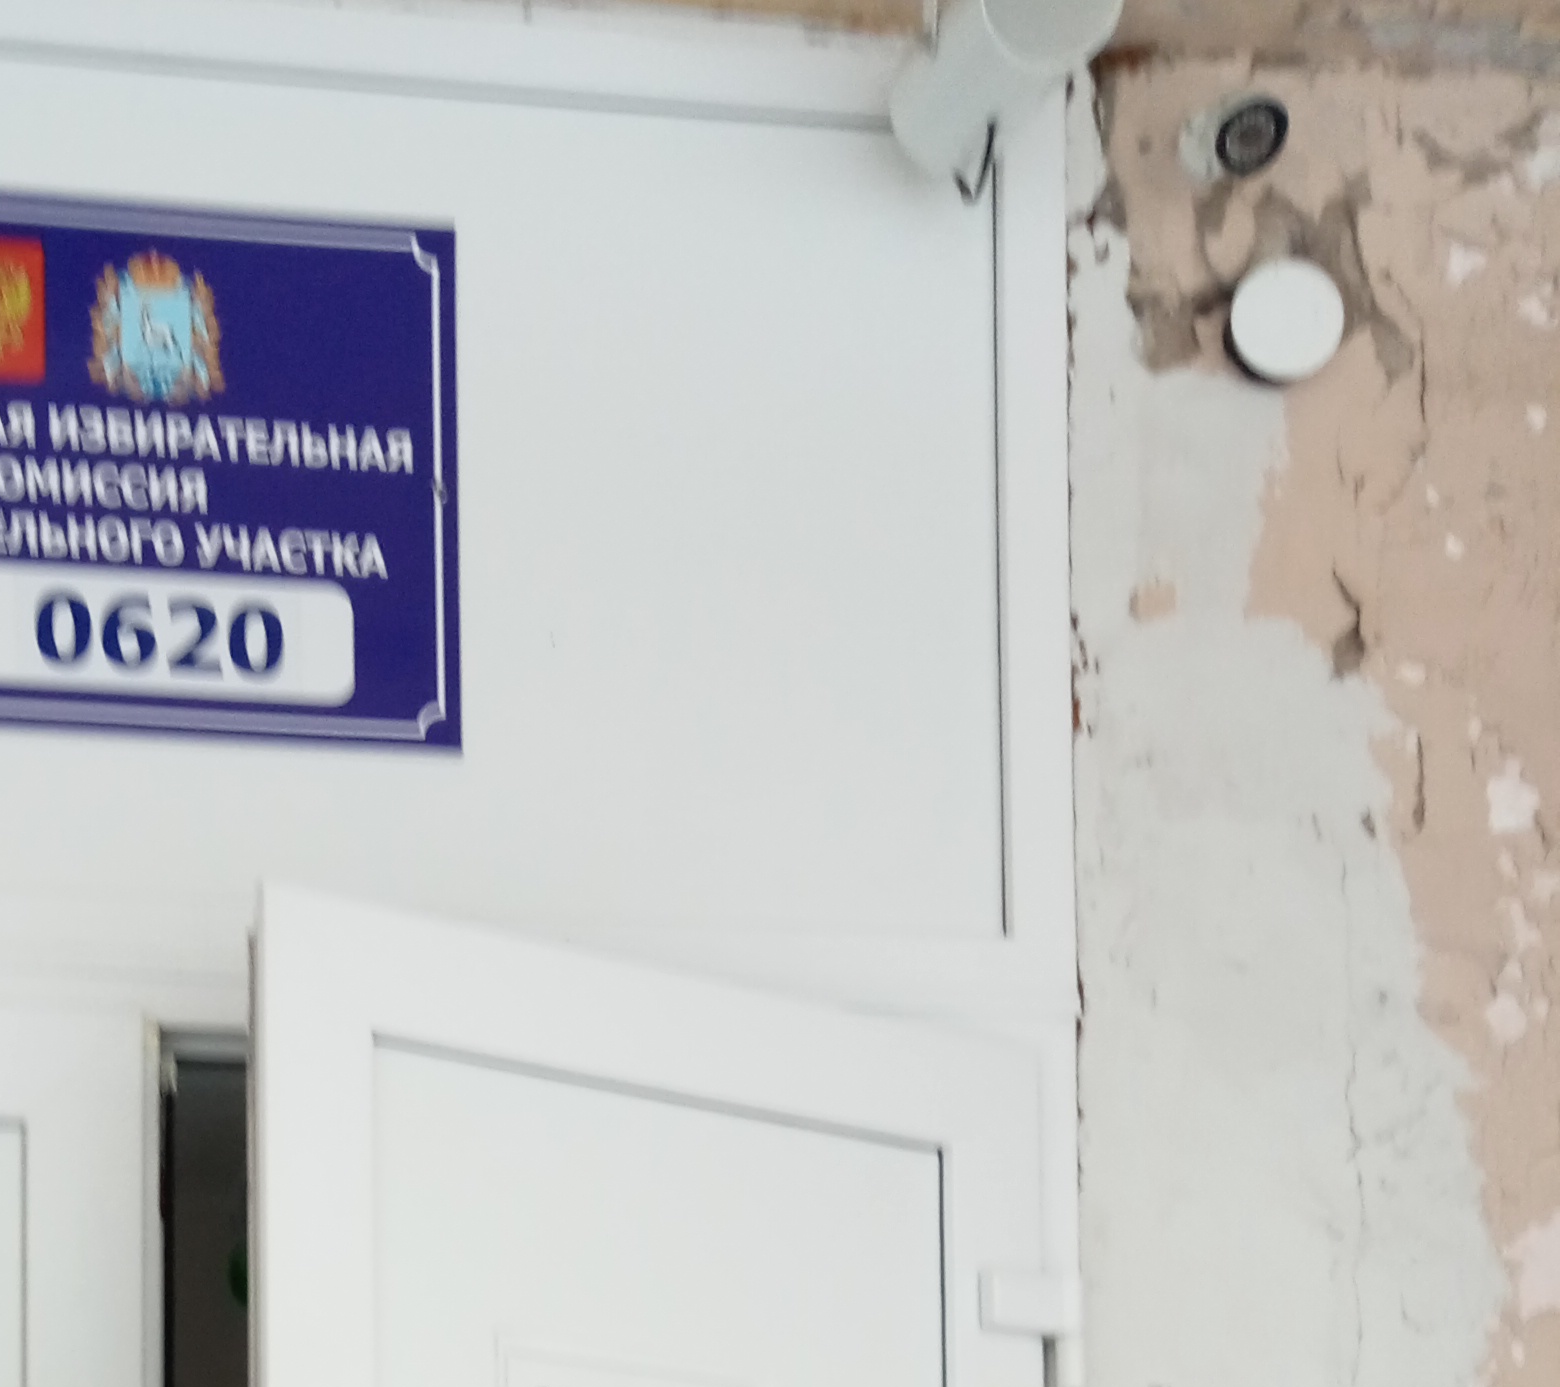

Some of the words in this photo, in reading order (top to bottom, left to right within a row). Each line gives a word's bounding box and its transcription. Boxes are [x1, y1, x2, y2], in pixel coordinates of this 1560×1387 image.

[47, 401, 414, 474] ИЗБИРАТЕЛЬНАЯ
[195, 520, 388, 579] УЧАСТКА
[34, 588, 286, 680] 0620
